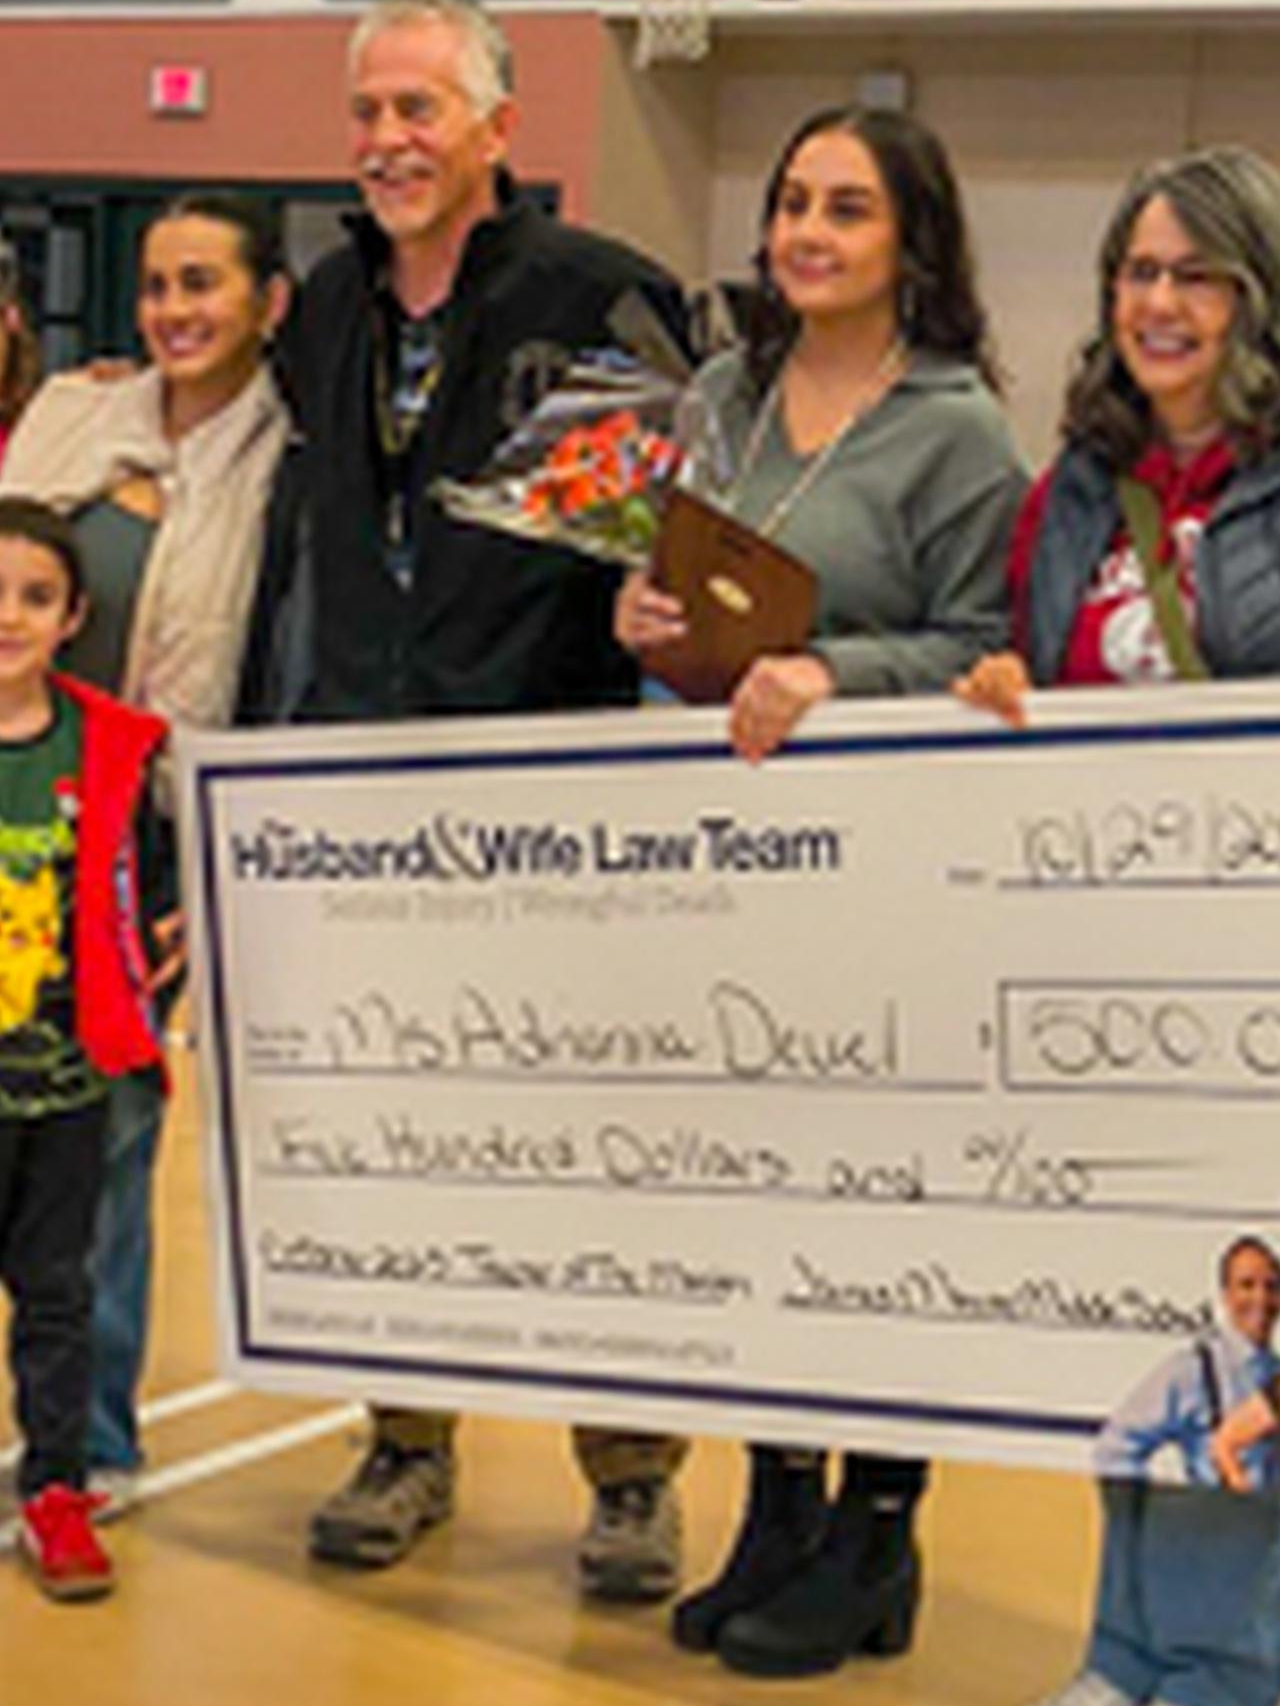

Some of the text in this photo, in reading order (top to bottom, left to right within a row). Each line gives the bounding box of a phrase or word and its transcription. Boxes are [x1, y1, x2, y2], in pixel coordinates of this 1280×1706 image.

[230, 823, 432, 881] Husband
[478, 823, 584, 877] Wife
[595, 823, 698, 873] Law
[698, 816, 844, 871] Team
